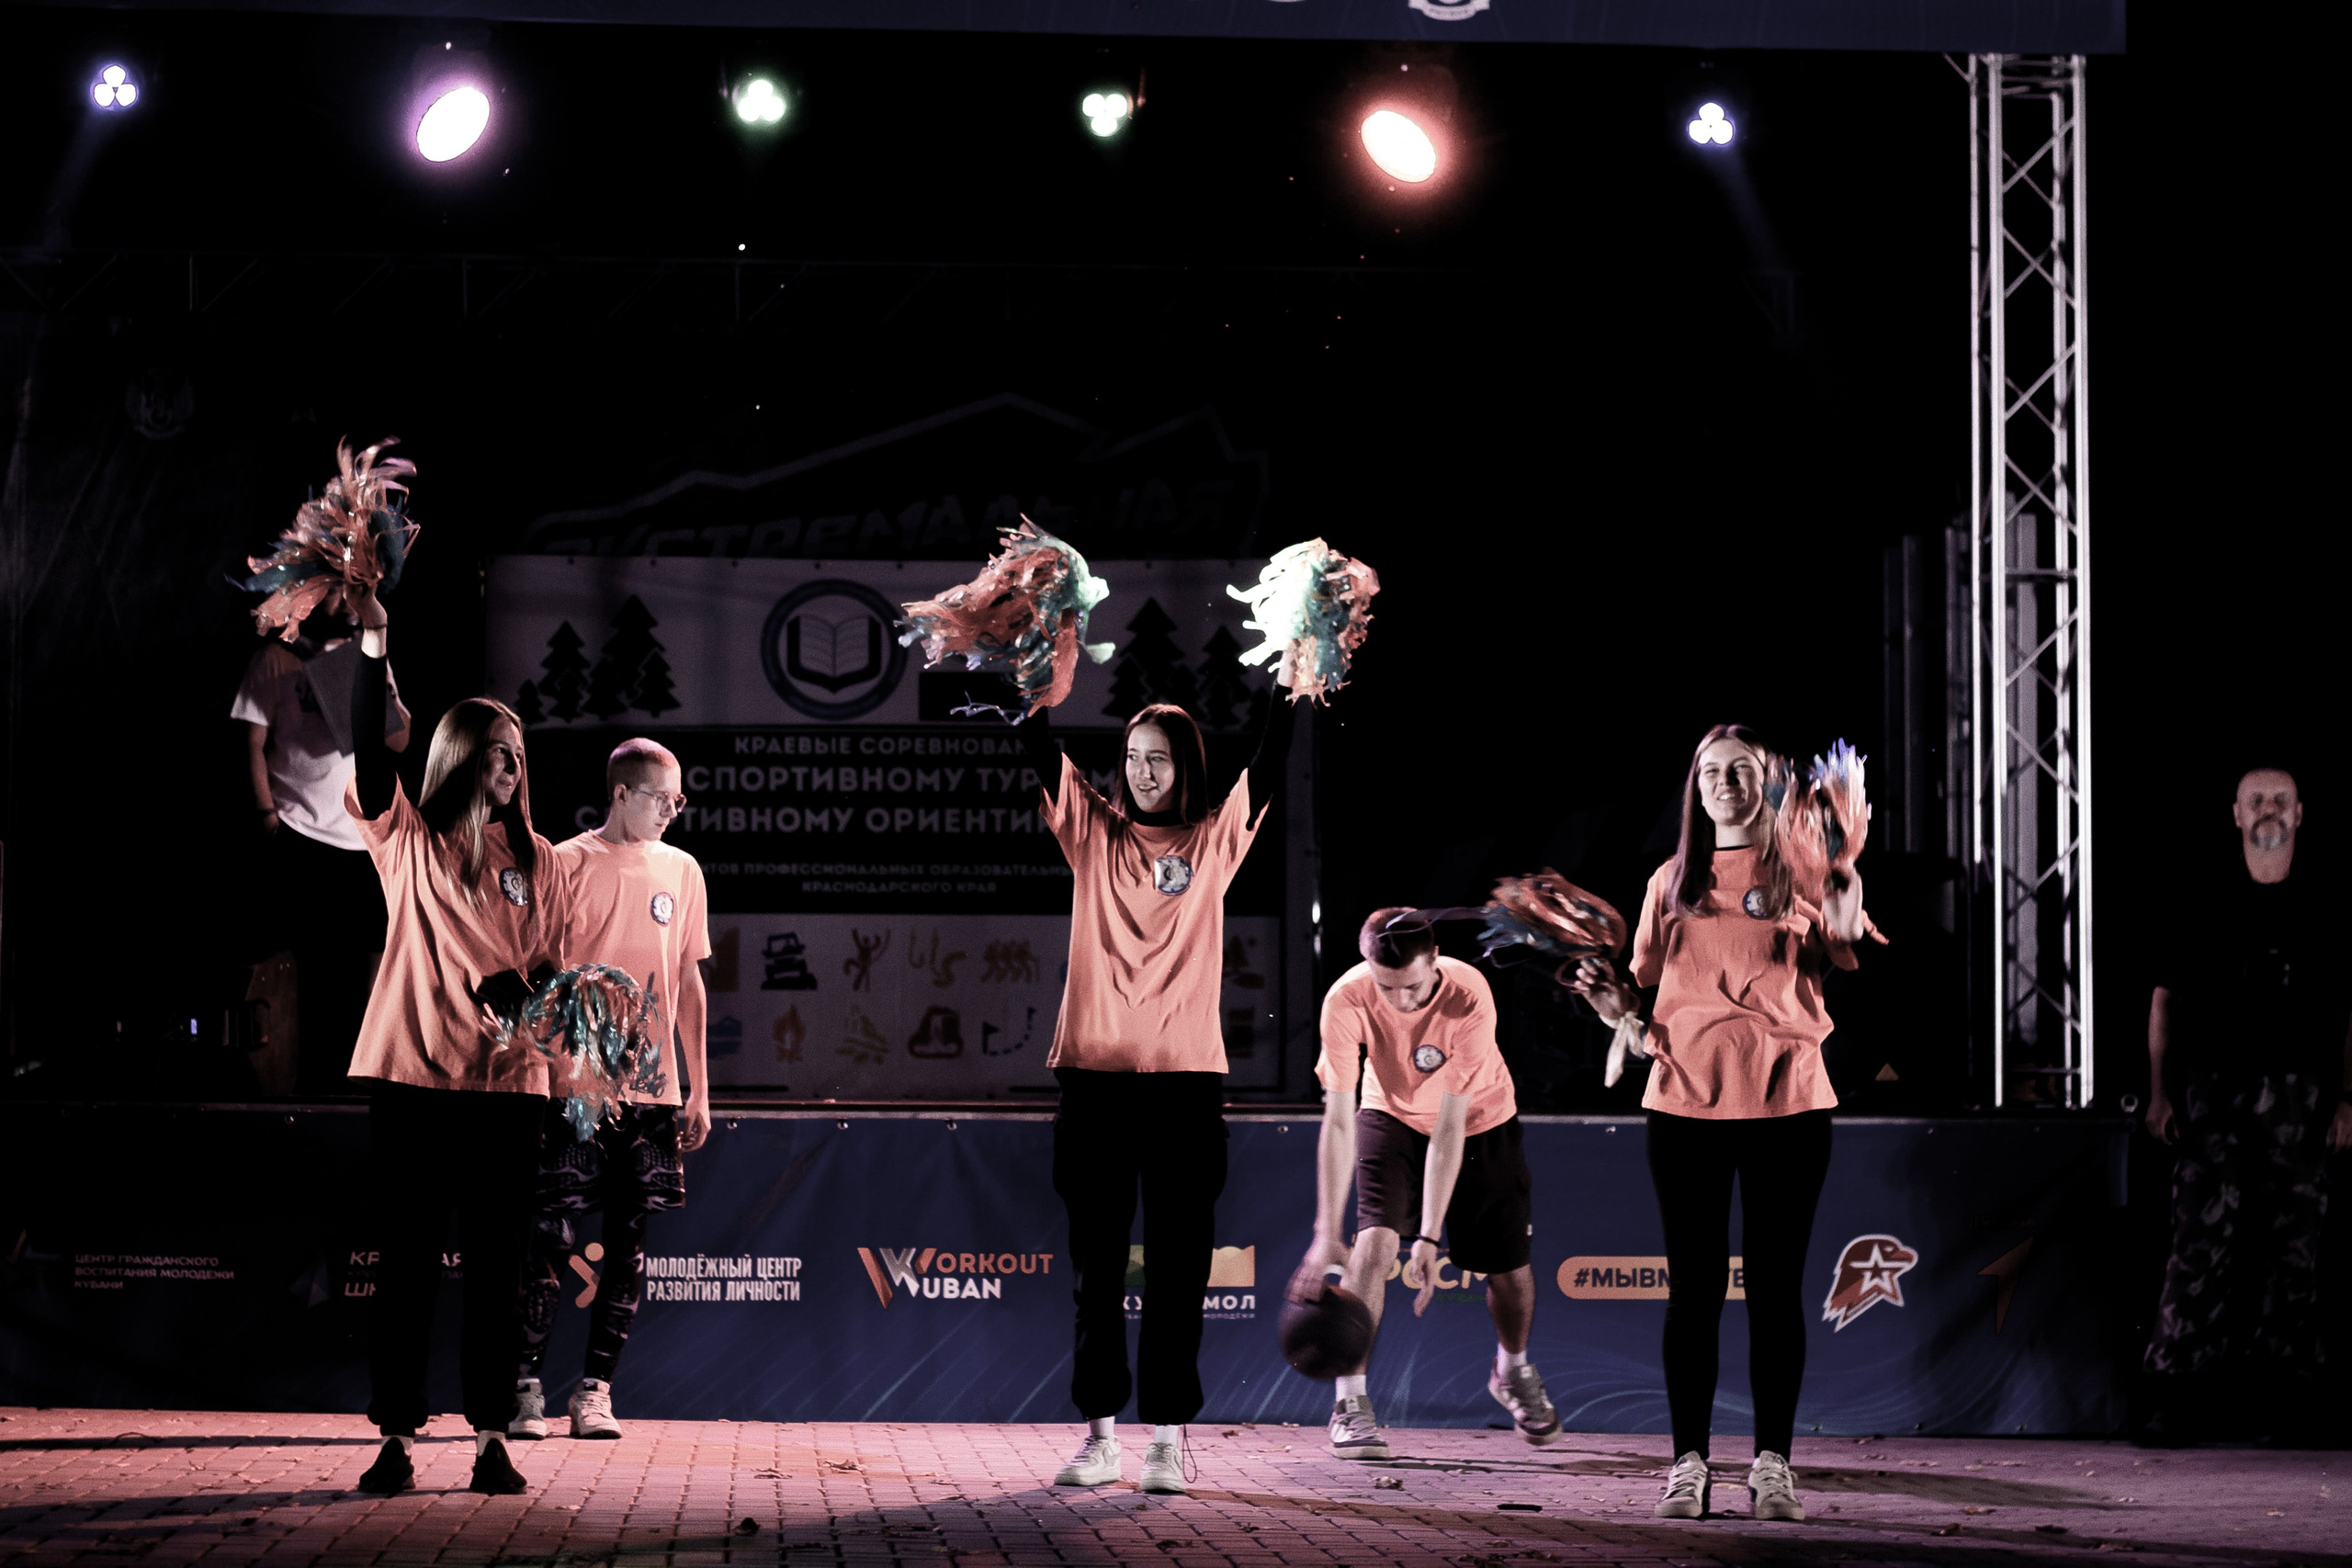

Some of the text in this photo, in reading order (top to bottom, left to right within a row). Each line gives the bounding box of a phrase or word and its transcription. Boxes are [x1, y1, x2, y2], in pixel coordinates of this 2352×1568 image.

[736, 737, 851, 756] КРАЕВЫЕ
[687, 766, 965, 793] СПОРТИВНОМУ
[744, 862, 924, 876] ПРОФЕССИОНАЛЬНЫХ
[802, 881, 997, 895] КРАСНОДАРСКОГО КРАЯ
[75, 1254, 220, 1268] ЦЕНТР ГРАЖДАНСКОГО
[646, 1254, 803, 1280] МОЛОДЁЖНЫЙ ЦЕНТР
[74, 1267, 157, 1278] ВОСПИТАНИЯ
[74, 1280, 124, 1290] КУБАНИ
[647, 1280, 801, 1302] РАЗВИТИЯ ЛИЧНОСТИ
